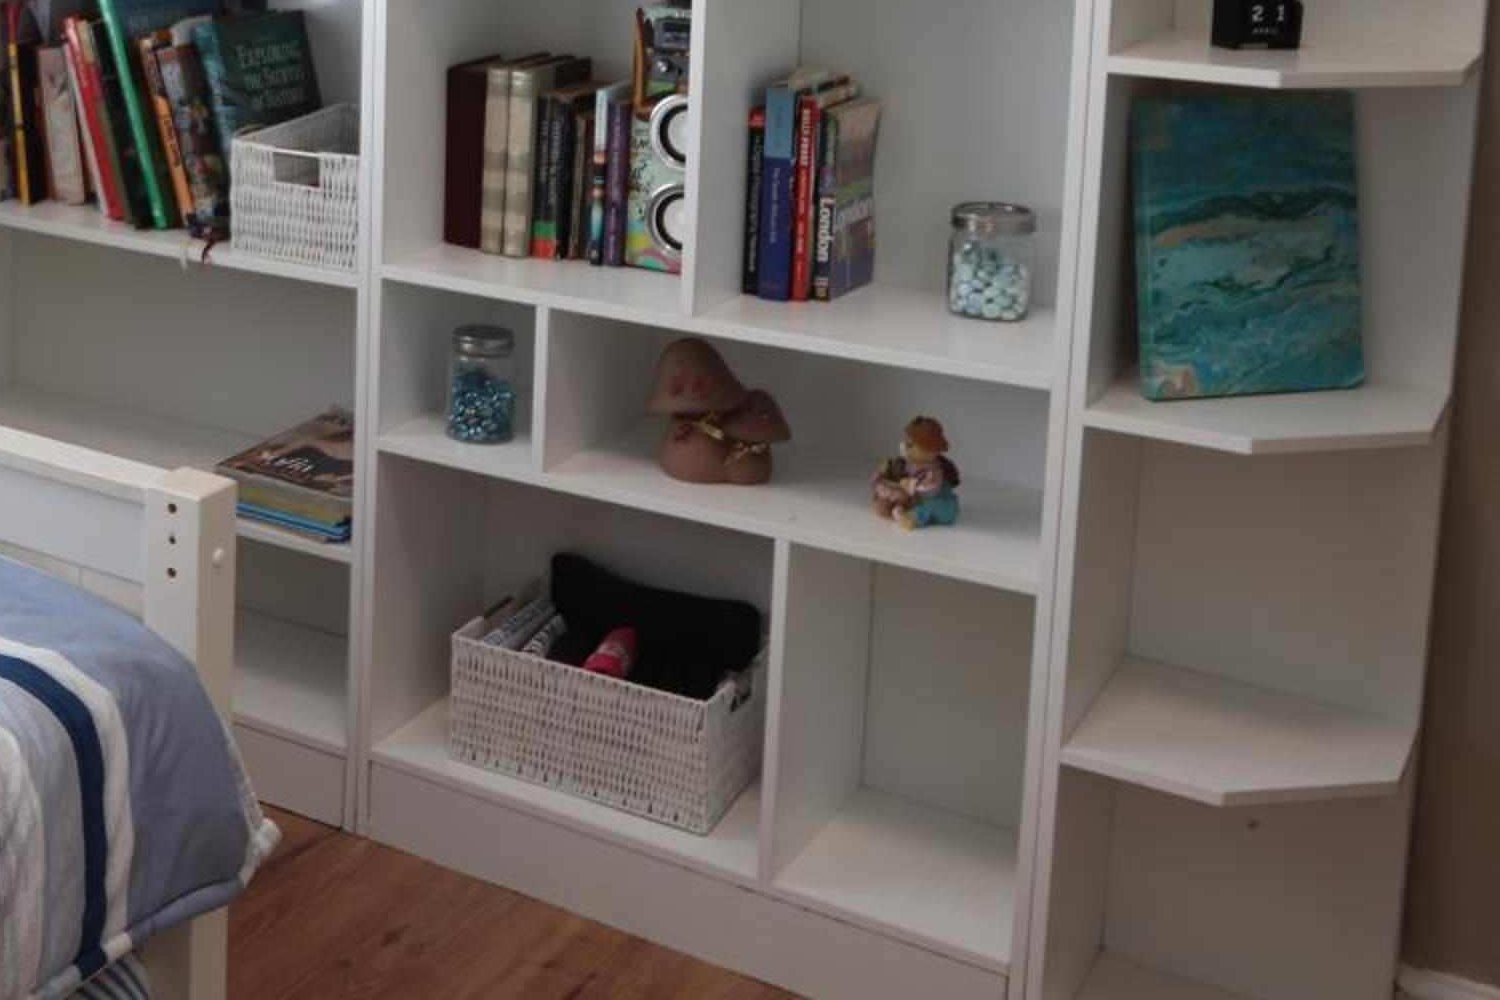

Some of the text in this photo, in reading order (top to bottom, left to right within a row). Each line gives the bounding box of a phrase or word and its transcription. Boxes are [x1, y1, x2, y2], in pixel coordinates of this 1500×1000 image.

[1251, 4, 1285, 22] 2 1
[817, 197, 835, 262] London
